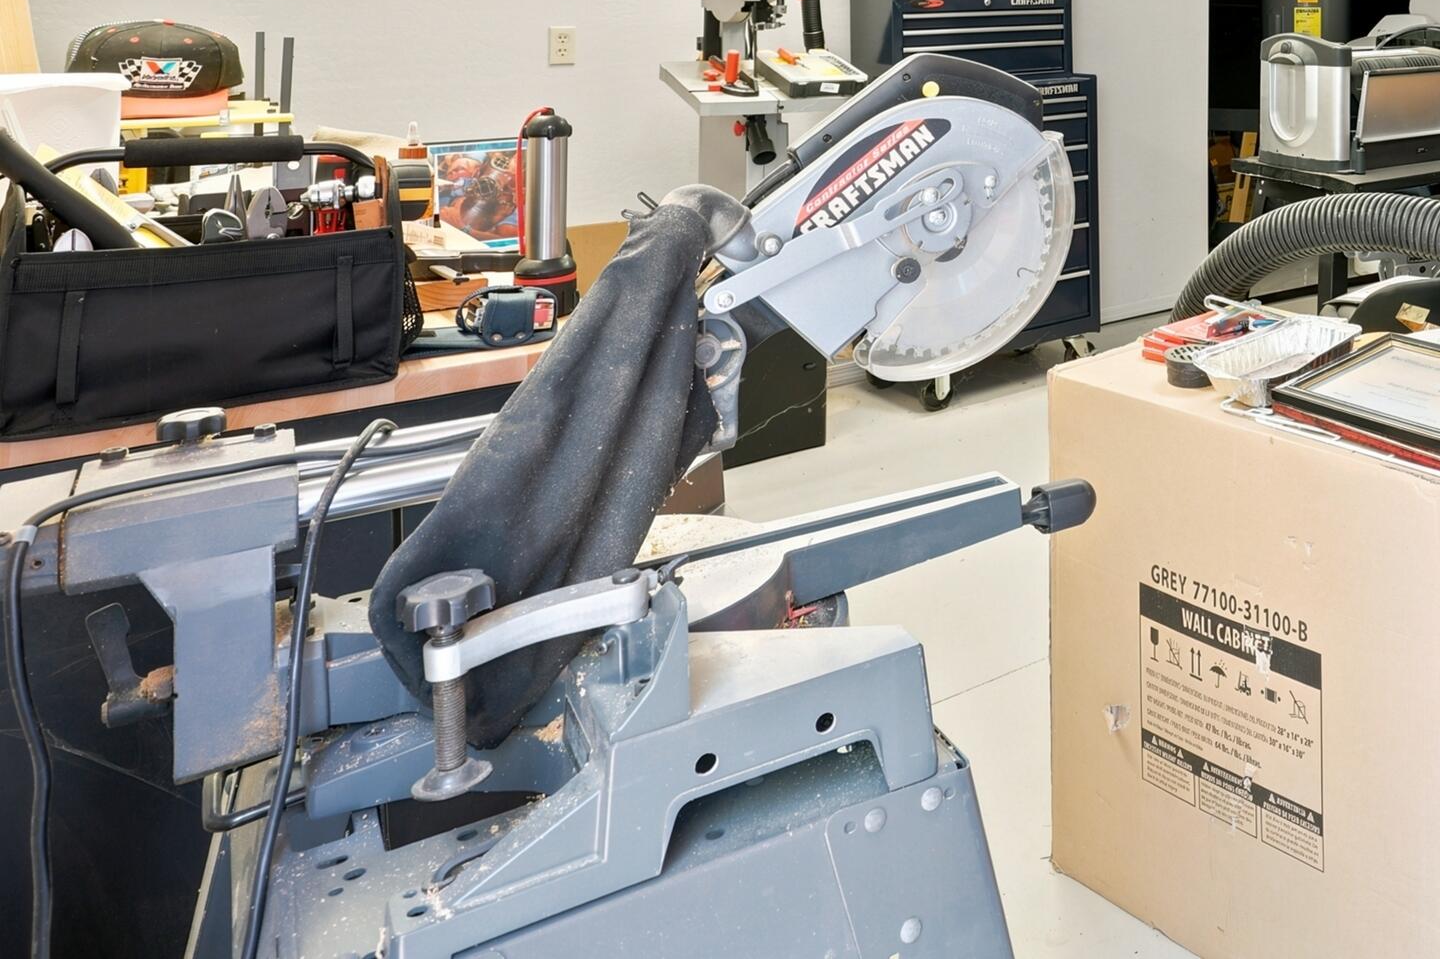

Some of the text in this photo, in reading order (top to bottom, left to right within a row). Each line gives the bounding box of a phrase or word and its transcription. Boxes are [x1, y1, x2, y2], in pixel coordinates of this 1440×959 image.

[1040, 83, 1079, 96] RAFTSMAN
[799, 124, 936, 236] CRAFTSMAN
[805, 160, 870, 214] Contractor
[872, 125, 911, 158] Series
[1151, 565, 1308, 642] GREY 77100-31100-B
[1182, 607, 1215, 640] WALL
